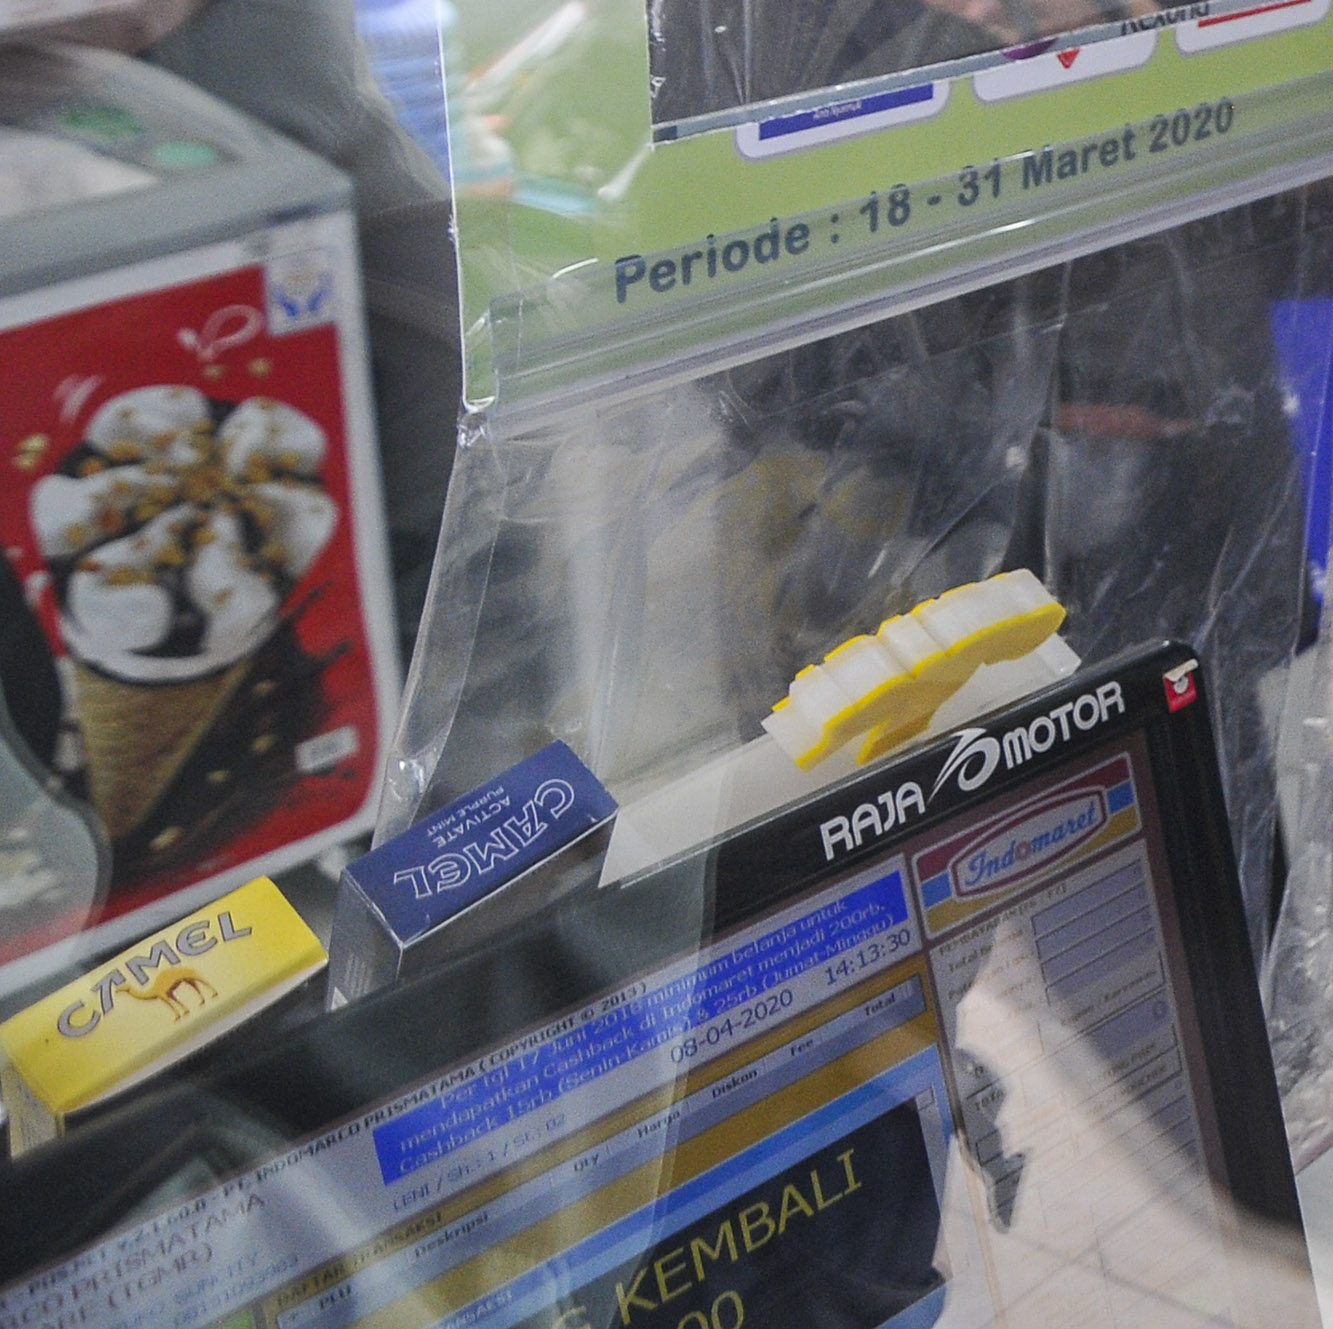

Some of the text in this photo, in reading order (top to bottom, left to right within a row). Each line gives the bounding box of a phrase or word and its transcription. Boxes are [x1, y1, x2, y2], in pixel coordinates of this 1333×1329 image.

[615, 217, 810, 305] Periode
[859, 182, 912, 233] 18
[957, 157, 1003, 207] 31
[1022, 123, 1138, 191] Maret
[1149, 96, 1236, 154] 2020
[426, 784, 506, 838] PURPLE MINT
[431, 794, 512, 850] ACTIVATE
[818, 680, 1127, 861] RAJA MOTOR
[393, 778, 576, 900] CAMEL
[963, 803, 1098, 889] Indomaret
[56, 911, 253, 1041] CAMEL
[549, 1025, 587, 1056] Juni
[591, 998, 641, 1034] 2018
[645, 956, 730, 1006] minimum
[732, 922, 797, 966] belanja
[799, 898, 847, 931] untuk
[822, 925, 913, 986] 14:13:30
[363, 1064, 475, 1128] PRISMATAMA
[489, 1015, 576, 1067] COPYRIGHT
[398, 898, 885, 1154] mendapatkan Cashback di Indomaret menjadi 200rb.
[398, 1113, 499, 1176] Cashback
[505, 1085, 553, 1122] 15rb
[714, 980, 759, 1014] 25rb
[667, 986, 796, 1066] 08-04-2020
[413, 1212, 490, 1259] Deskripsi
[710, 1068, 759, 1100] Diskon
[789, 1037, 814, 1057] Fee
[863, 992, 896, 1017] Total
[614, 1148, 863, 1327] KEMBALI
